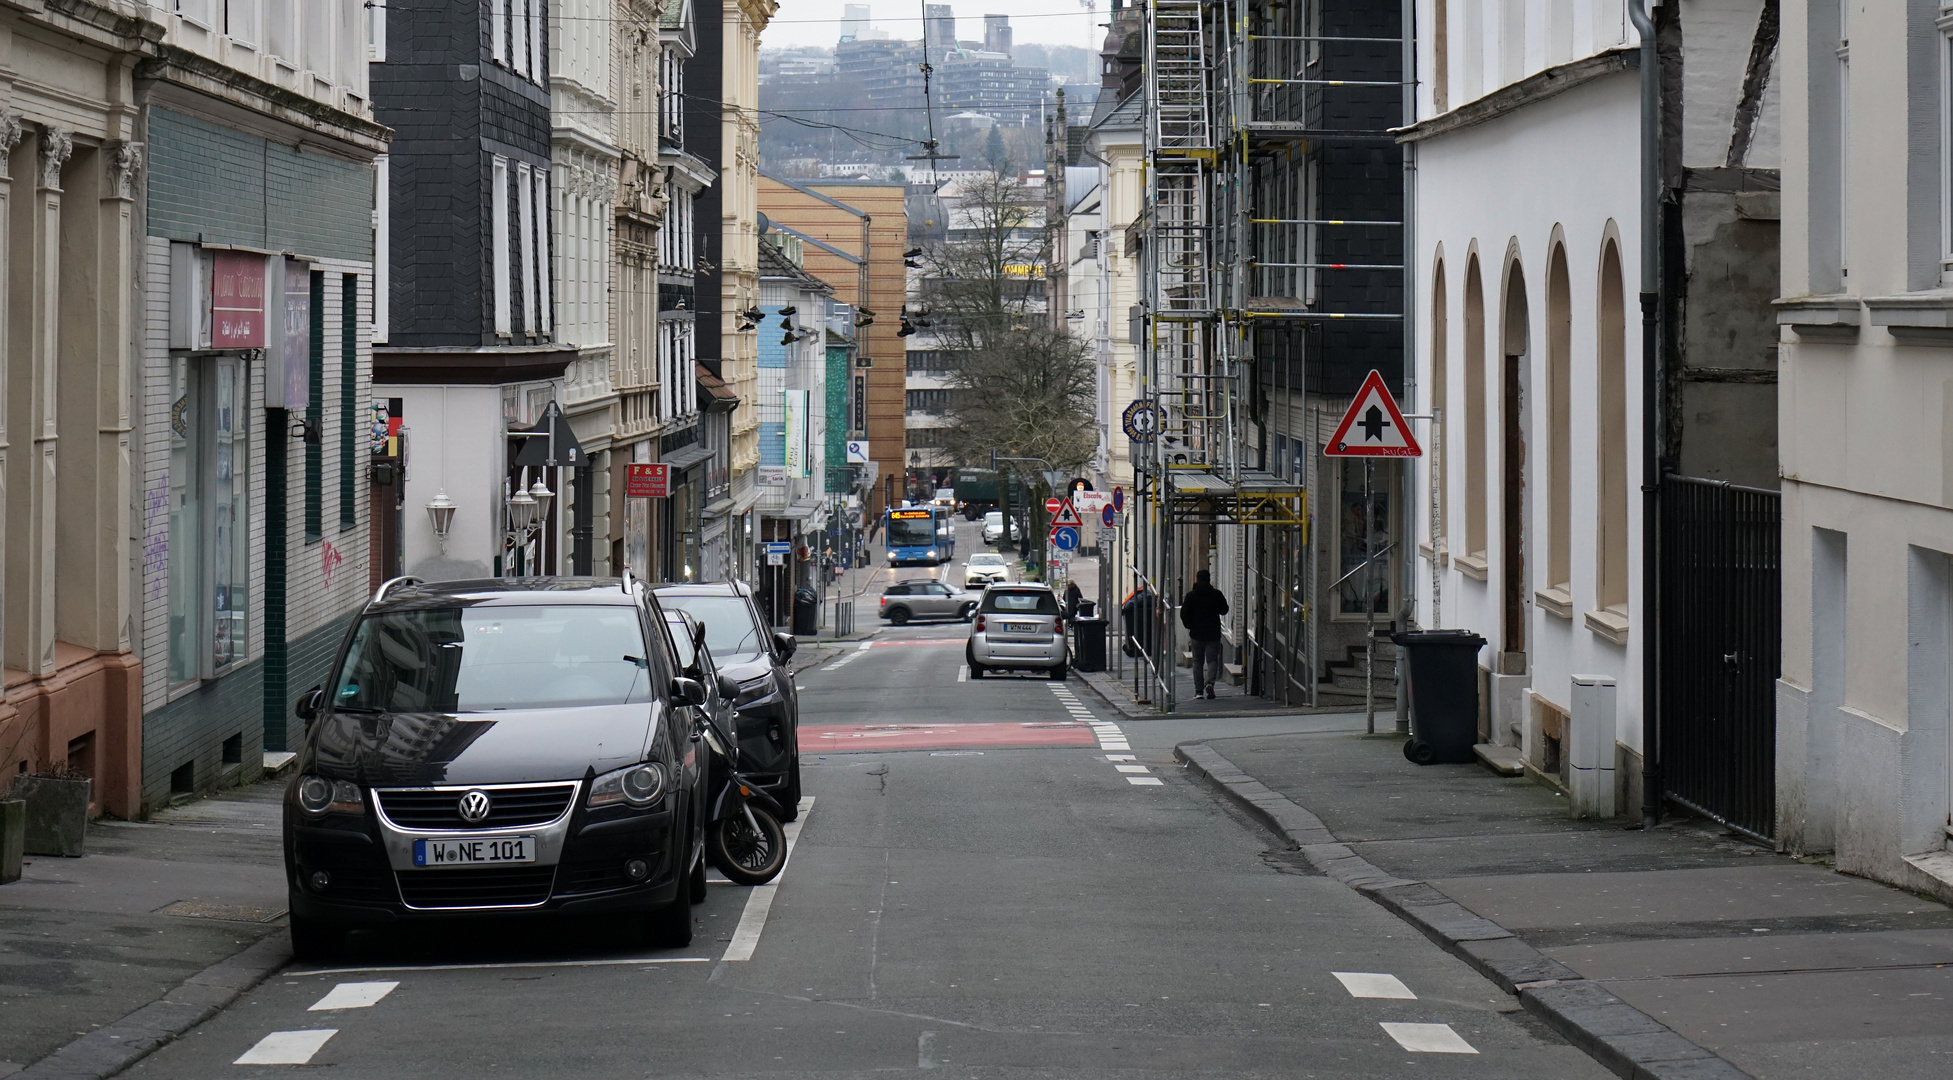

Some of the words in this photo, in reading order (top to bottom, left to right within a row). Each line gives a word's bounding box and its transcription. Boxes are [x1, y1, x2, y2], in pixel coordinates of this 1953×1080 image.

[634, 467, 640, 475] F
[656, 467, 662, 475] S
[433, 843, 445, 862] W
[459, 842, 485, 861] NE
[489, 841, 526, 860] 101
